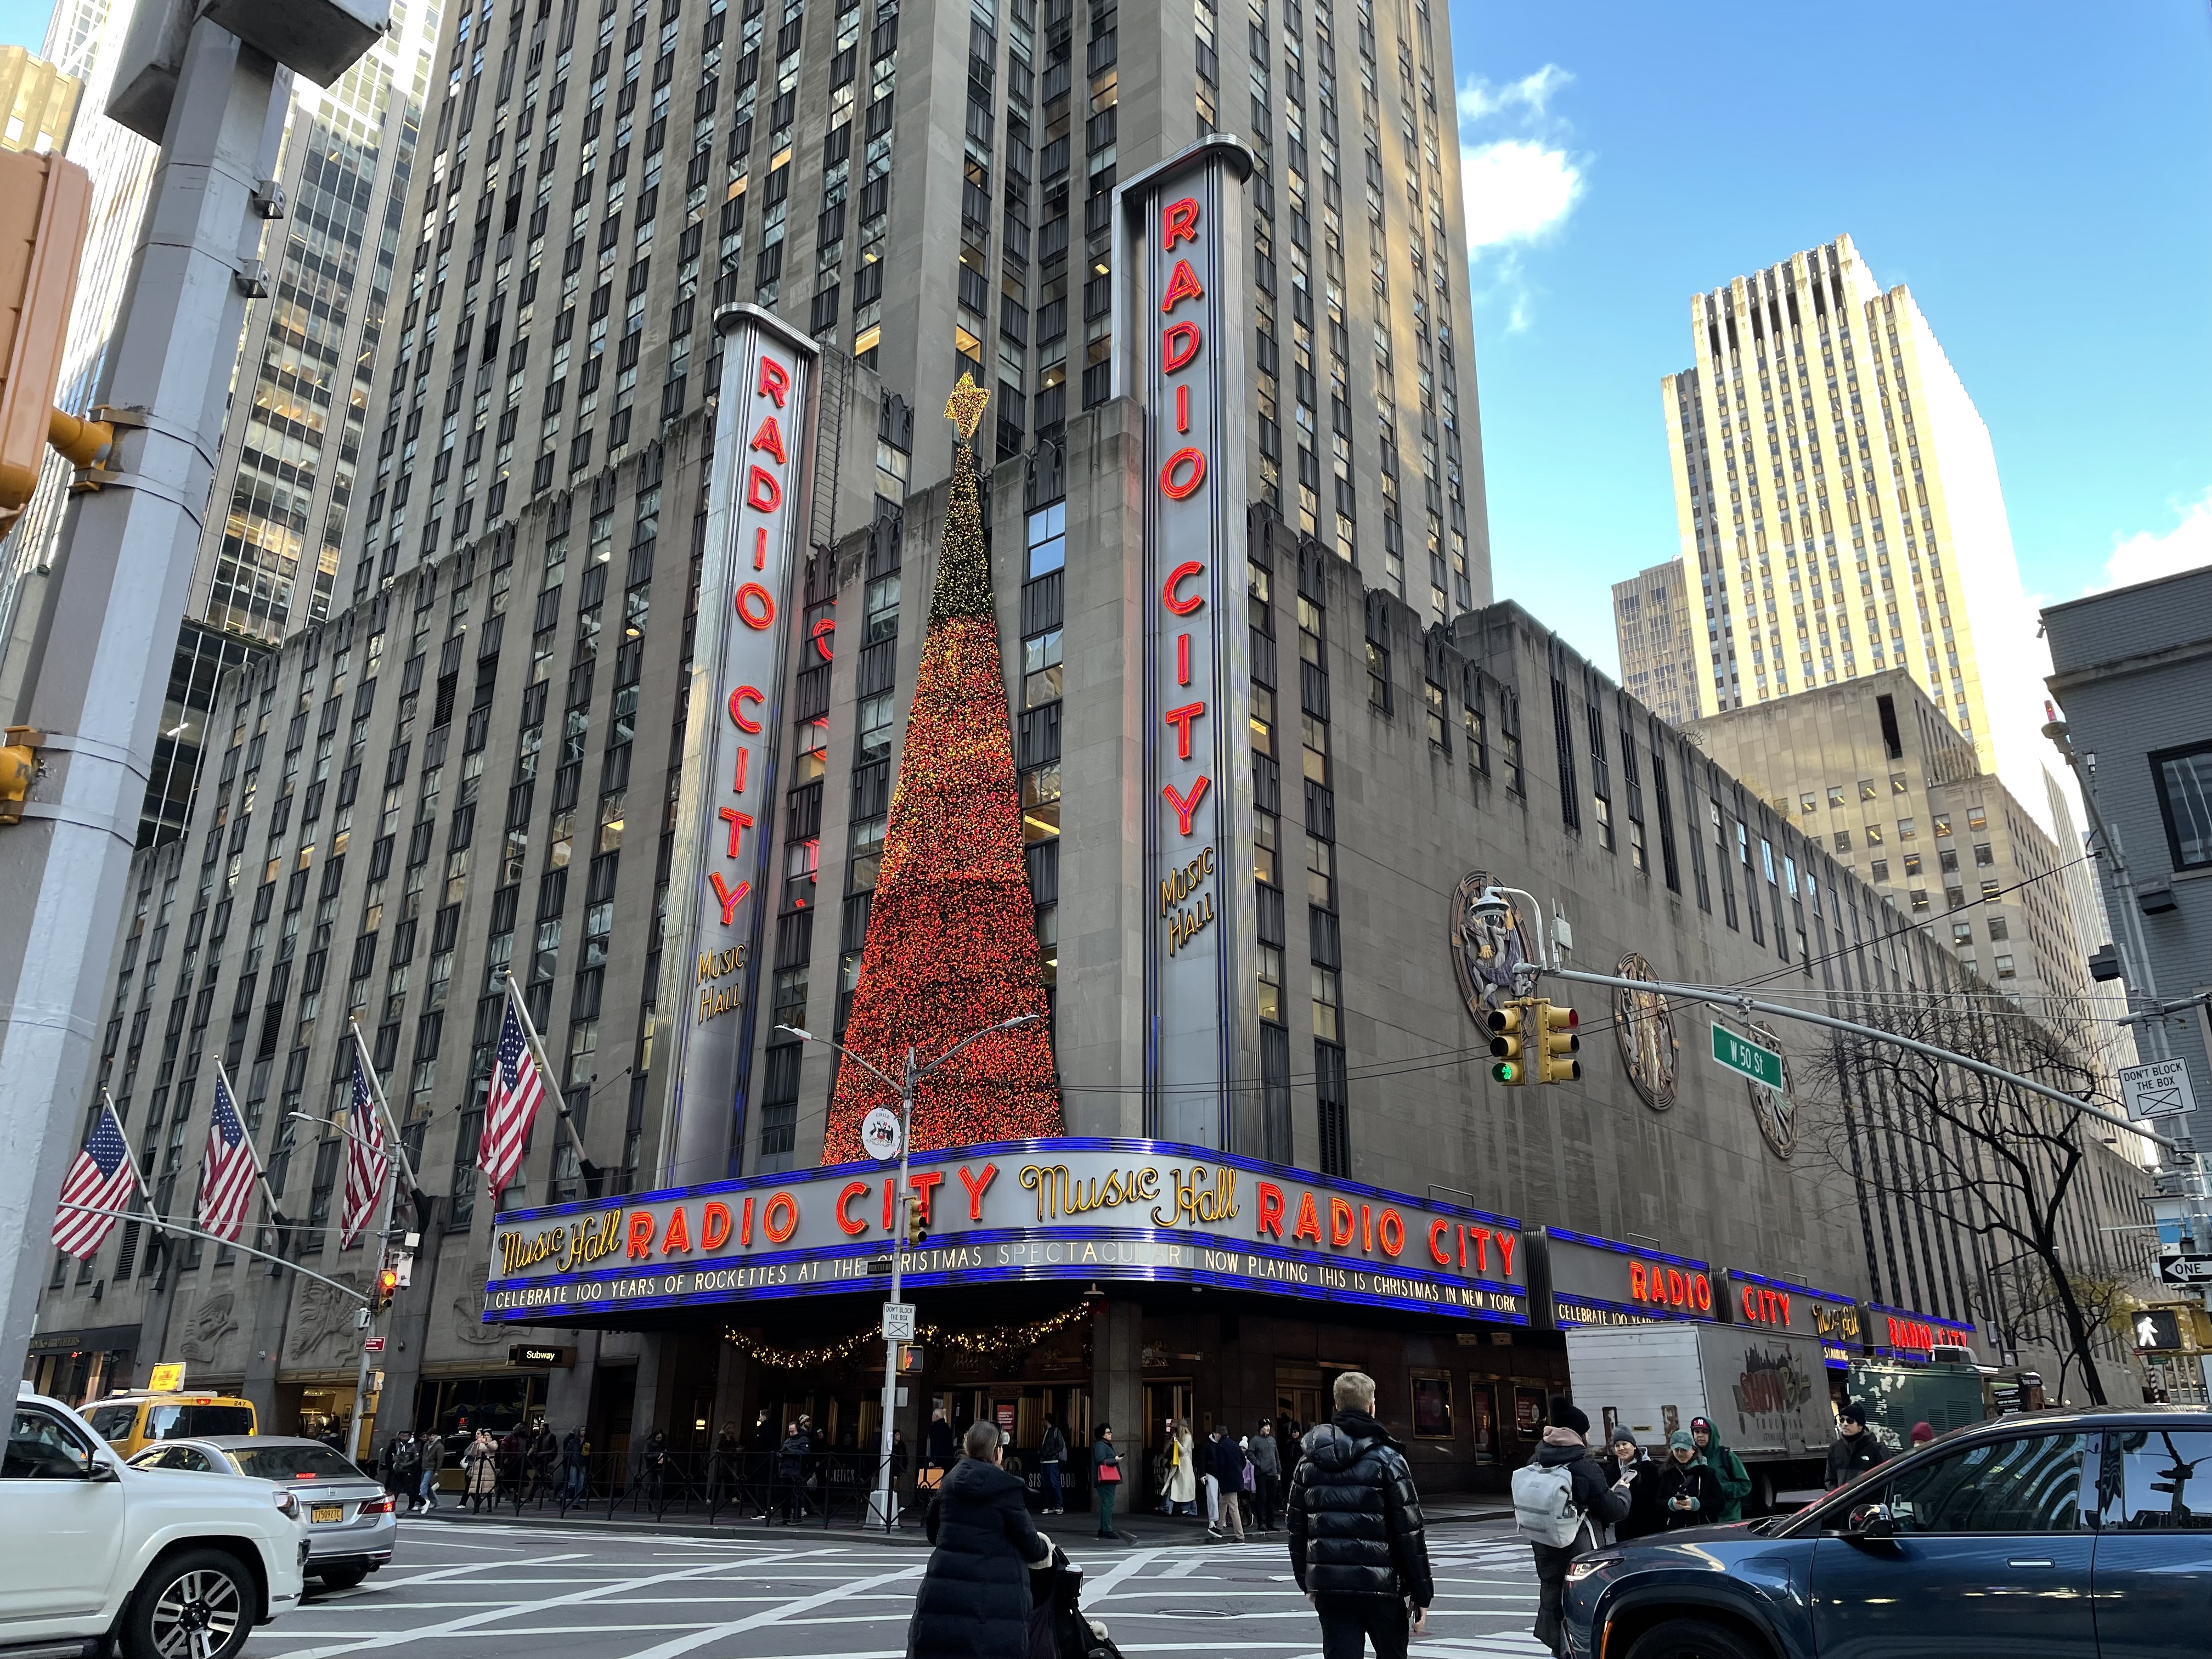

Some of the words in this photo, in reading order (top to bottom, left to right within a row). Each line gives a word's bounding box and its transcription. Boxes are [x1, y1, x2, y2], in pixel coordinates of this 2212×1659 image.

[1161, 198, 1207, 499] RADIO
[736, 355, 790, 630] RADIO
[1162, 561, 1211, 836] CITY
[709, 685, 765, 925] CITY
[1730, 1040, 1737, 1062] W
[1740, 1045, 1751, 1069] 50
[1754, 1052, 1763, 1075] St
[2124, 1069, 2149, 1082] DON'T
[2152, 1062, 2183, 1076] BLOCK
[2136, 1080, 2154, 1091] THE
[2157, 1076, 2175, 1087] BOX
[500, 1226, 563, 1276] Music
[556, 1208, 623, 1272] Hall
[627, 1192, 800, 1260] RADIO
[836, 1162, 1000, 1236] CITY
[1019, 1164, 1160, 1222] Music
[1152, 1165, 1239, 1228] Hall
[1257, 1181, 1406, 1257] RADIO
[1428, 1218, 1516, 1276] CITY
[495, 1286, 567, 1308] CELEBRATE
[576, 1282, 602, 1300] 100
[611, 1277, 654, 1297] YEARS
[664, 1274, 685, 1290] OF
[695, 1265, 787, 1289] ROCKETTES
[797, 1261, 820, 1280] AT
[833, 1257, 862, 1277] THE
[878, 1246, 982, 1272] RISTMAS
[1205, 1249, 1239, 1271] NOW
[1248, 1255, 1308, 1283] PLAYING
[1318, 1266, 1346, 1289] THIS
[1354, 1273, 1366, 1290] IS
[1373, 1277, 1439, 1302] CHRISTMAS
[1446, 1286, 1457, 1304] IN
[1462, 1289, 1484, 1307] NEW
[1489, 1294, 1516, 1312] YORK
[1629, 1261, 1711, 1311] RADIO
[2175, 1263, 2203, 1274] ONE
[1559, 1304, 1607, 1325] CELEBRATE
[1612, 1312, 1627, 1324] 100
[1631, 1315, 1654, 1324] YEA
[1742, 1285, 1790, 1326] CITY
[1888, 1317, 1933, 1352] RADIO
[527, 1351, 555, 1361] Subway
[1029, 1473, 1075, 1487] SISOOD
